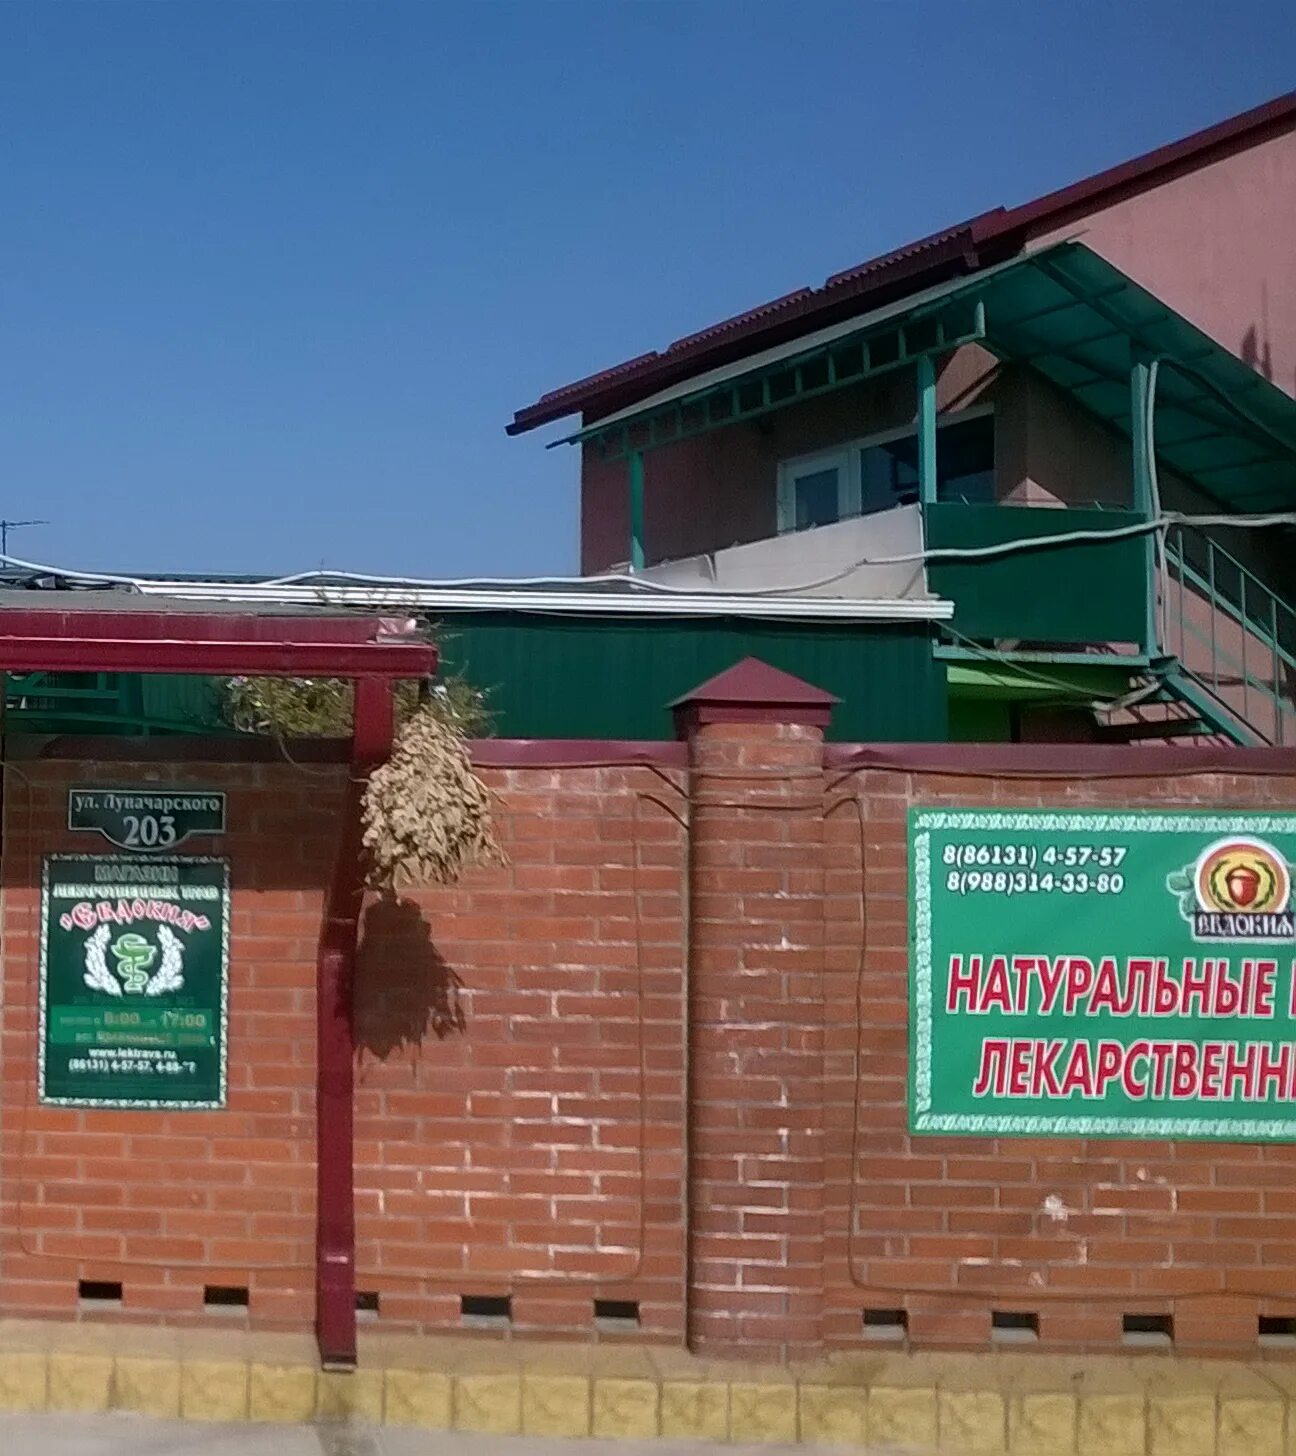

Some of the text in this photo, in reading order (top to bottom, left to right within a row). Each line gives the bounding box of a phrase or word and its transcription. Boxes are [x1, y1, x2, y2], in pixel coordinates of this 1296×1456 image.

[75, 794, 220, 814] ул. Луначарского
[123, 815, 177, 845] 203
[943, 845, 1128, 869] 8(86131) 4-57-57
[947, 872, 1124, 895] 8(988)314-33-80
[947, 954, 1277, 1019] НАТУРАЛЬНЫЕ
[973, 1037, 1296, 1102] ЛЕКАРСТВЕНН
